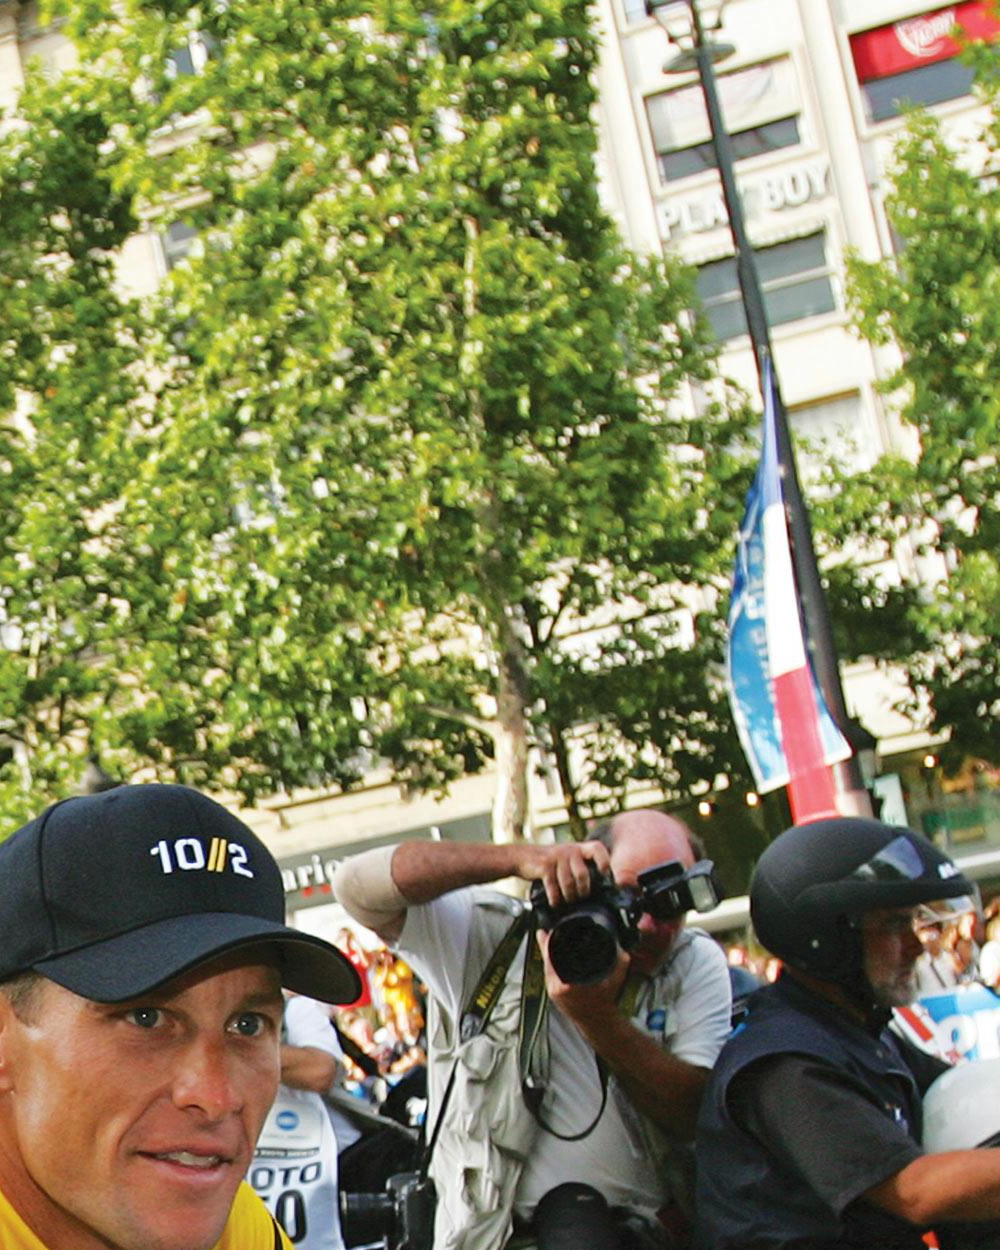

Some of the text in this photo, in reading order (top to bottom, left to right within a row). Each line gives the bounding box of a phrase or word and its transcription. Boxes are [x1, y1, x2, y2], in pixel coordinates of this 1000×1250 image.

[657, 168, 832, 240] PLABOY
[250, 1161, 322, 1191] OTO
[260, 1188, 308, 1245] 0
